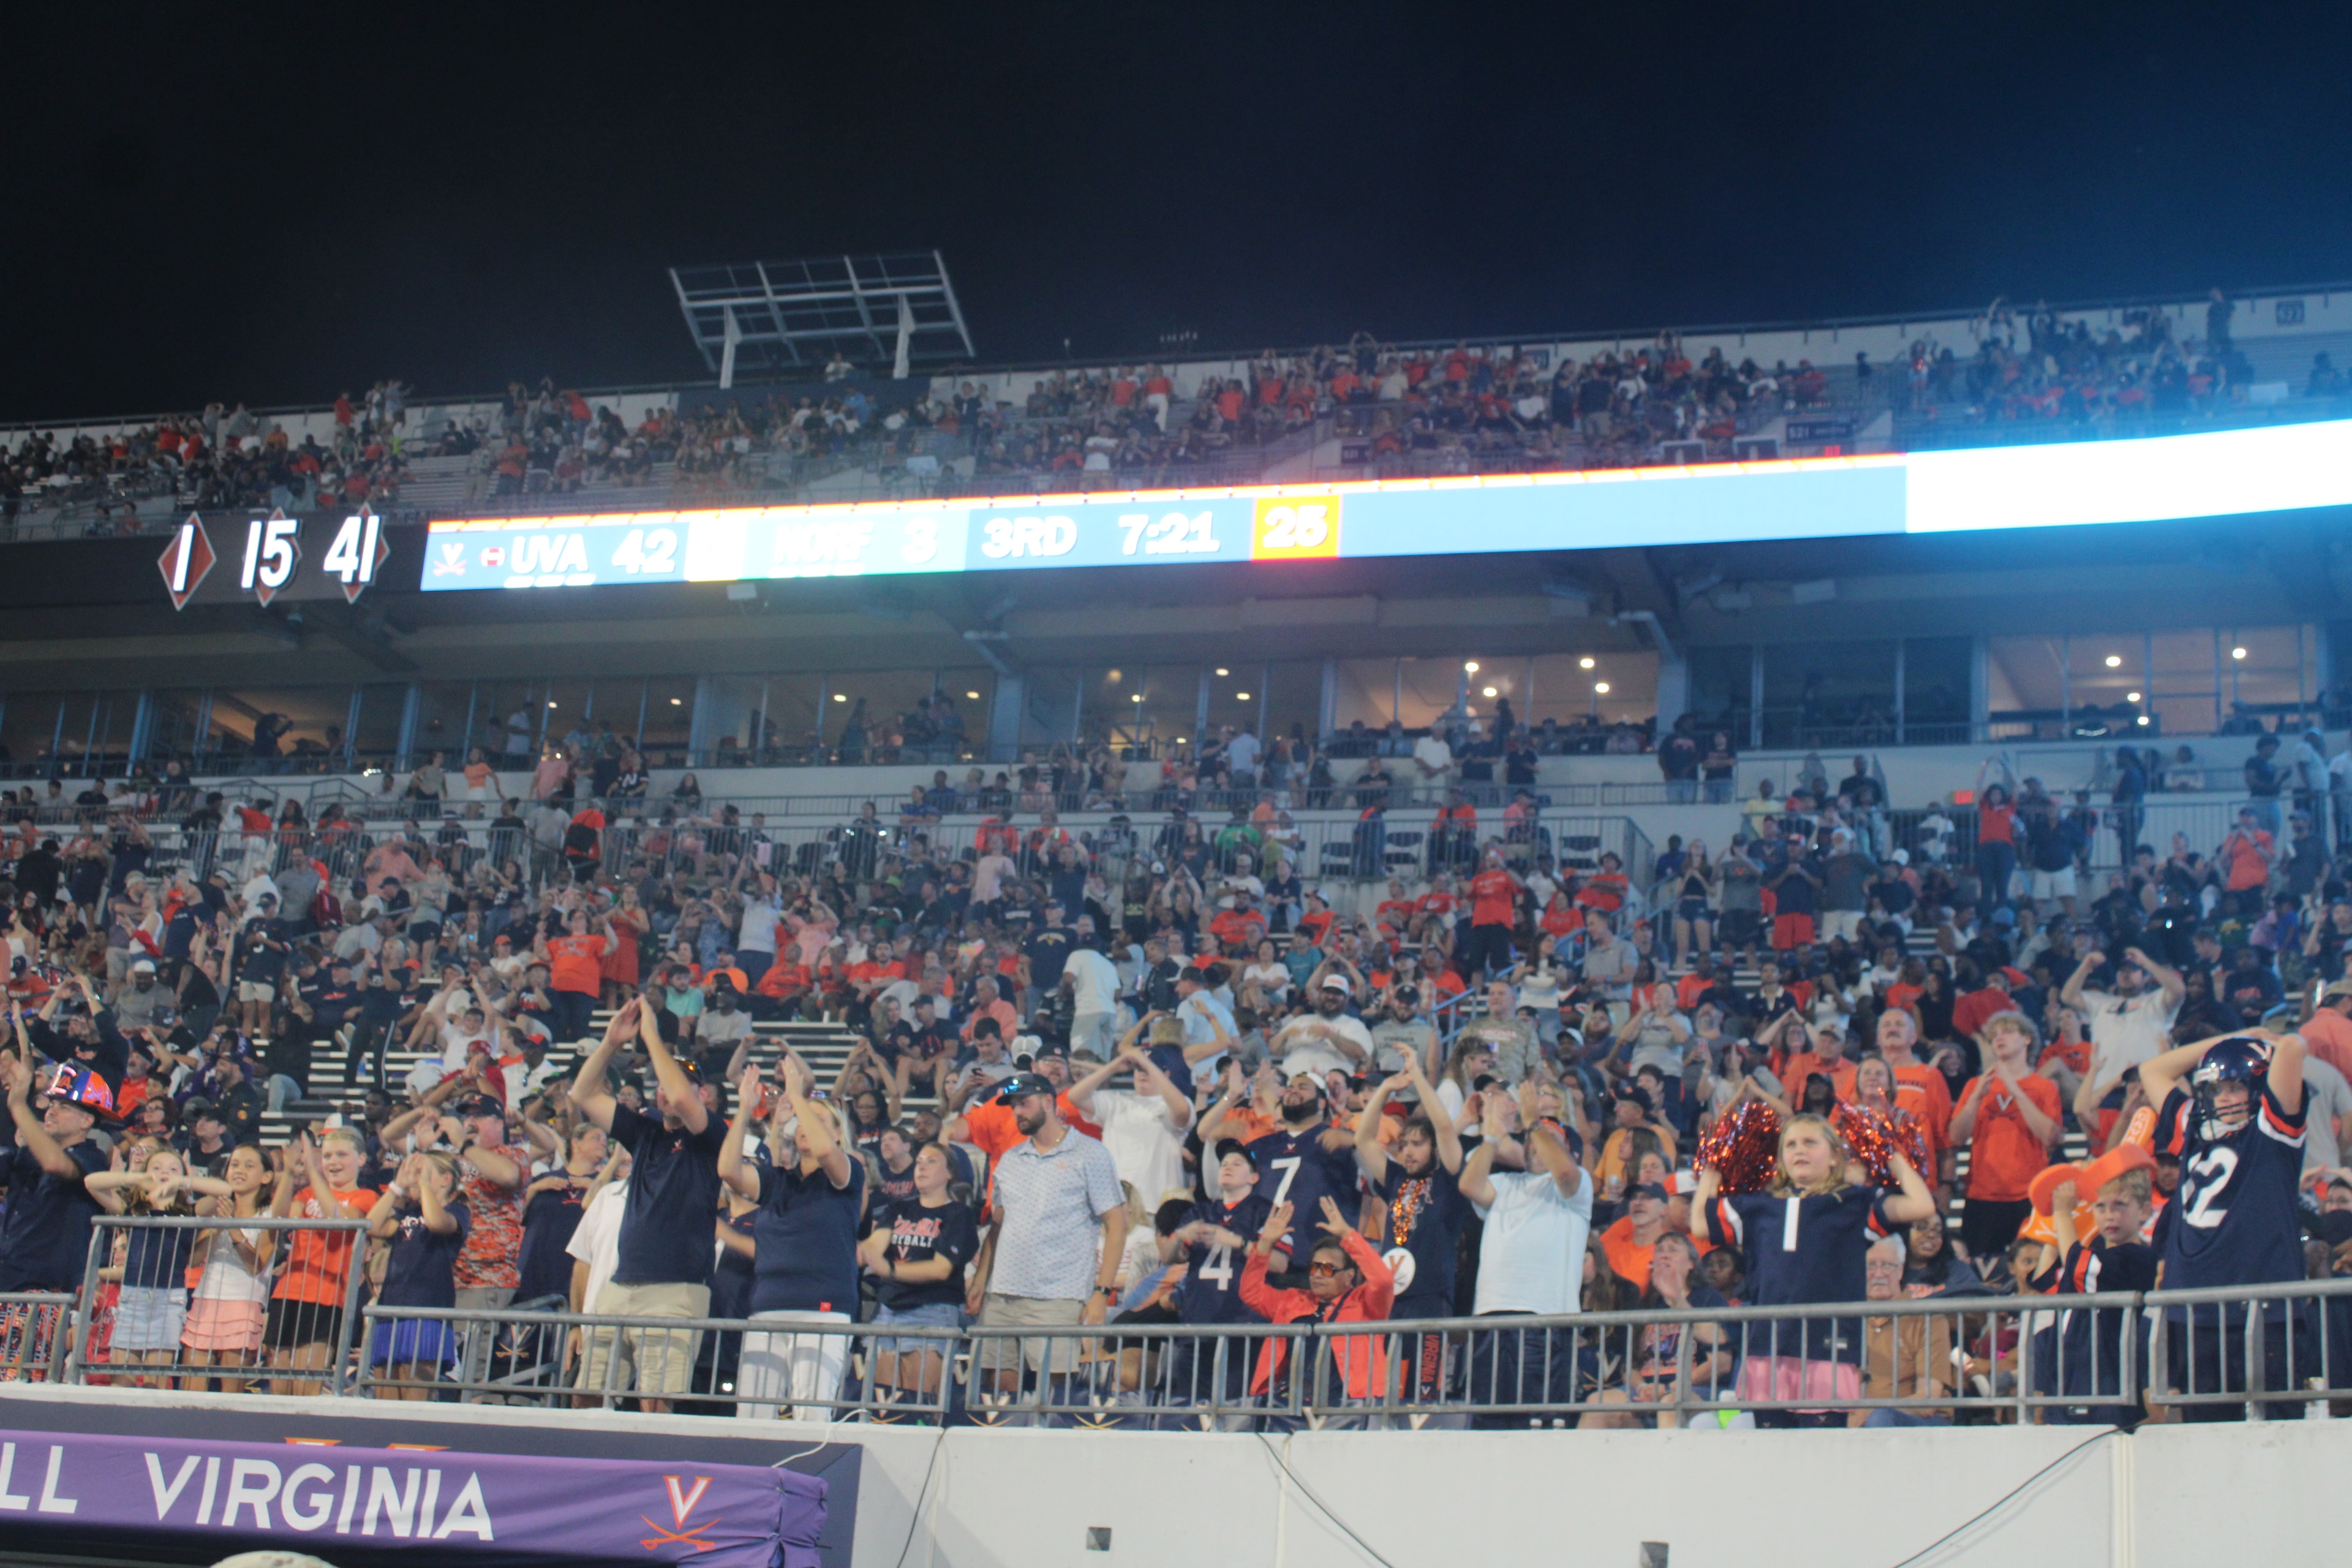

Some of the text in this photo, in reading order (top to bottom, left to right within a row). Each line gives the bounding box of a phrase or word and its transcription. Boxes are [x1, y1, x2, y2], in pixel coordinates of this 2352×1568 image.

[241, 519, 298, 589] 15
[323, 515, 380, 583] 41
[511, 534, 589, 574] UVA
[612, 529, 677, 575] 42
[902, 517, 938, 564] 3
[981, 516, 1078, 558] 3RD
[1118, 511, 1220, 555] 7:21
[1262, 505, 1329, 548] 25
[1271, 1156, 1302, 1208] 7
[1782, 1196, 1800, 1251] 1
[1199, 1242, 1233, 1291] 4
[144, 1452, 494, 1541] VIRGINIA
